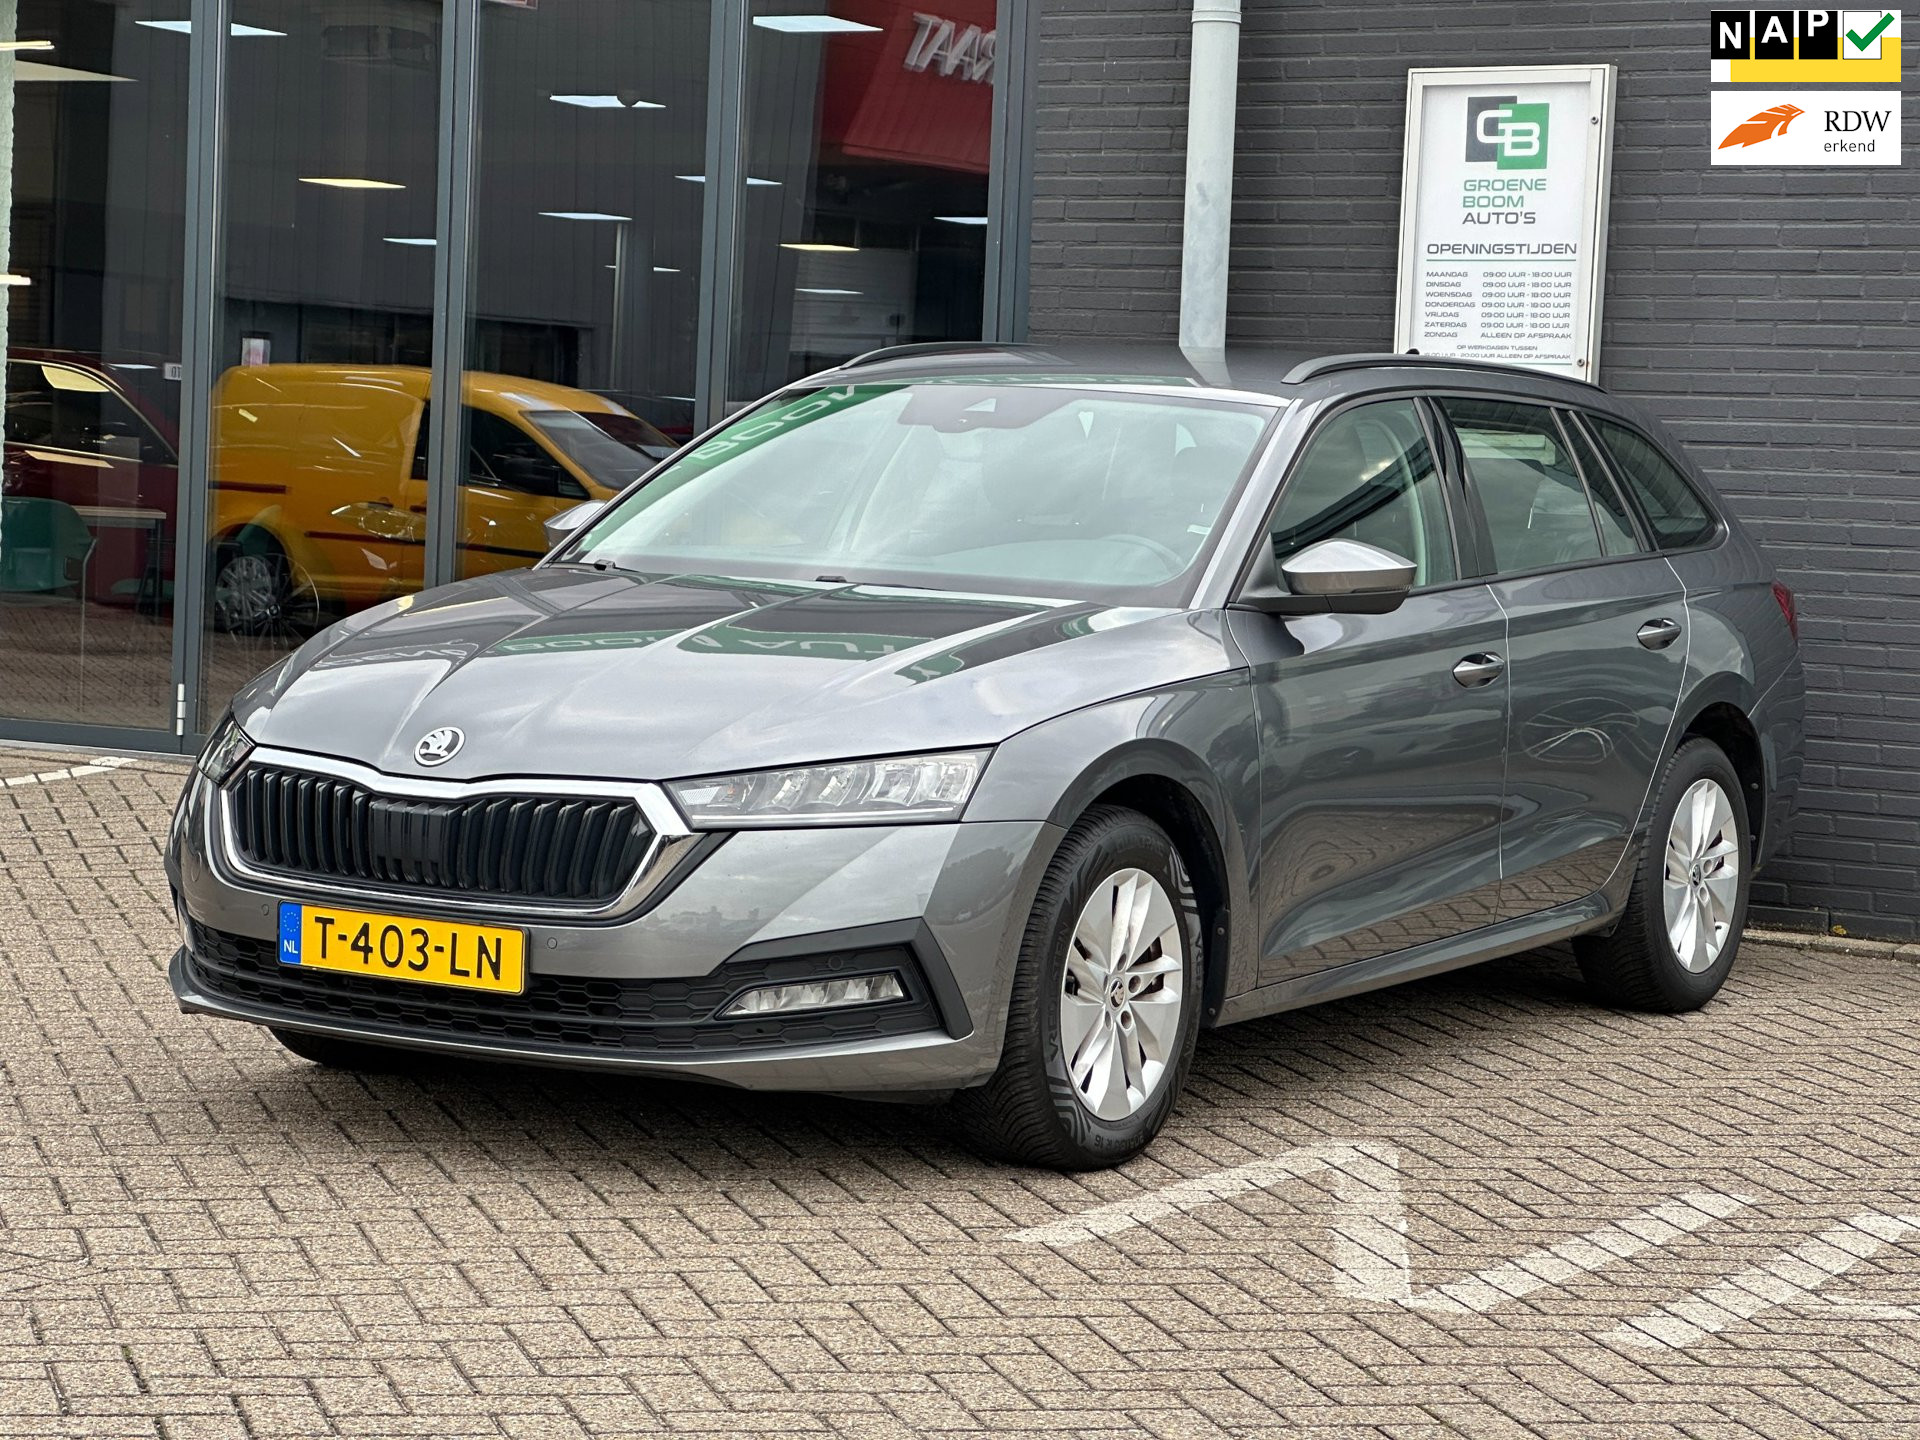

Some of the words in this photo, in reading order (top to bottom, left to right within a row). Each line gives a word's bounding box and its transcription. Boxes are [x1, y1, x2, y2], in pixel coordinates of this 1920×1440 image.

[1463, 178, 1547, 192] GROENE
[1462, 195, 1524, 208] BOOM
[1462, 211, 1536, 225] AUTO'S
[1427, 243, 1577, 255] OPENINGSTIJDEN
[283, 939, 299, 954] NL
[314, 916, 501, 981] T-403-LN
